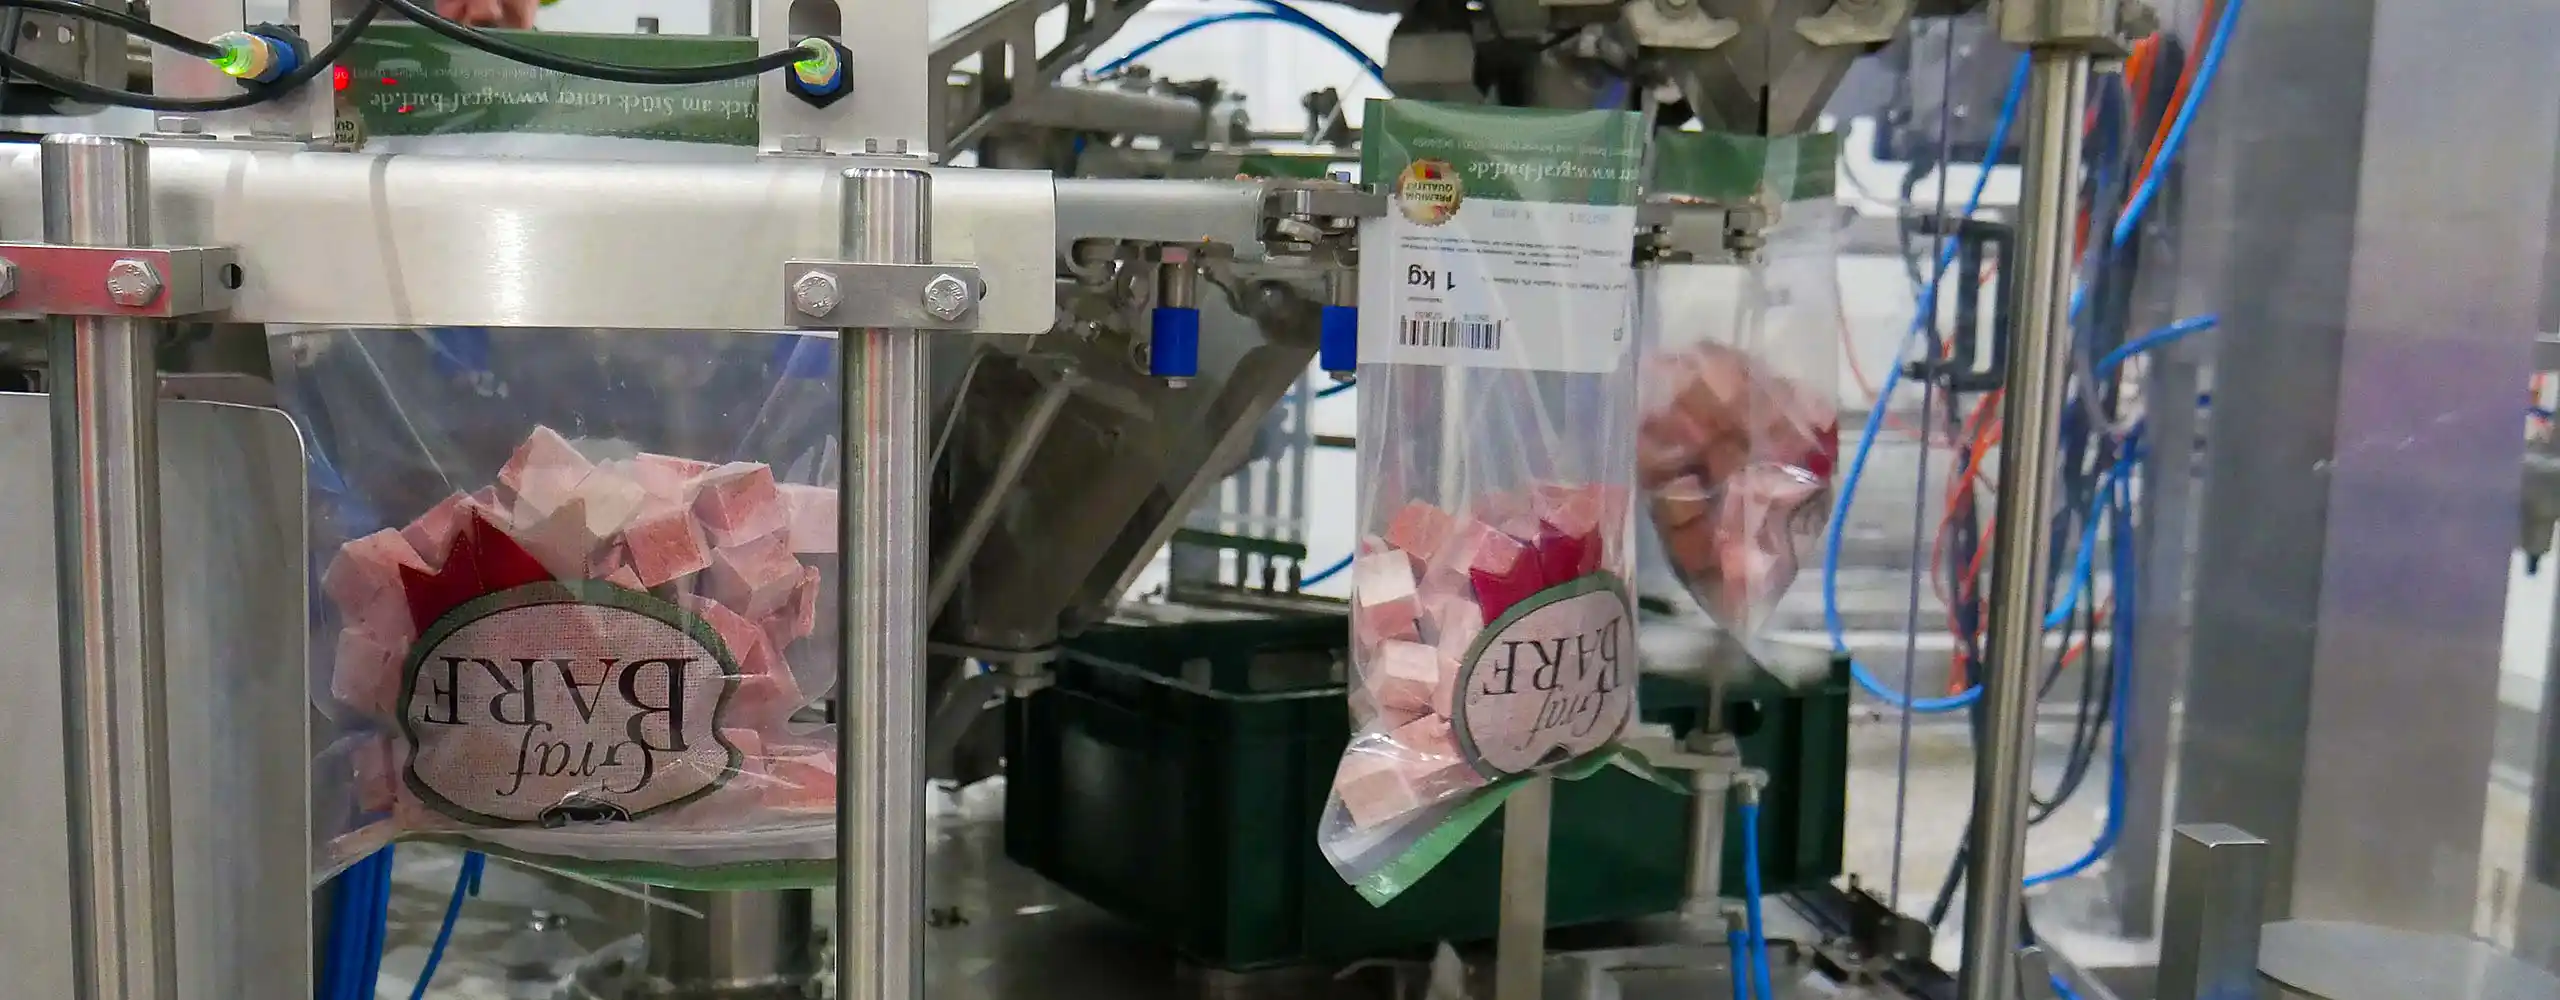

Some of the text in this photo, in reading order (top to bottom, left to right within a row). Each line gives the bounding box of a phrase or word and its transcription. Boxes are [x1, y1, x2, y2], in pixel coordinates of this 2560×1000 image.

[369, 87, 549, 113] www.graf-barf.de
[555, 90, 611, 109] unter
[618, 94, 674, 116] Stück
[682, 96, 712, 112] am
[1467, 160, 1616, 183] www.graf-barf.de
[1404, 191, 1453, 204] PREMIUM
[1406, 264, 1436, 291] kg
[1446, 271, 1457, 292] 1
[1483, 615, 1622, 696] BARF
[422, 657, 699, 753] BARF
[1512, 684, 1604, 752] Graf
[495, 722, 654, 796] Graf
